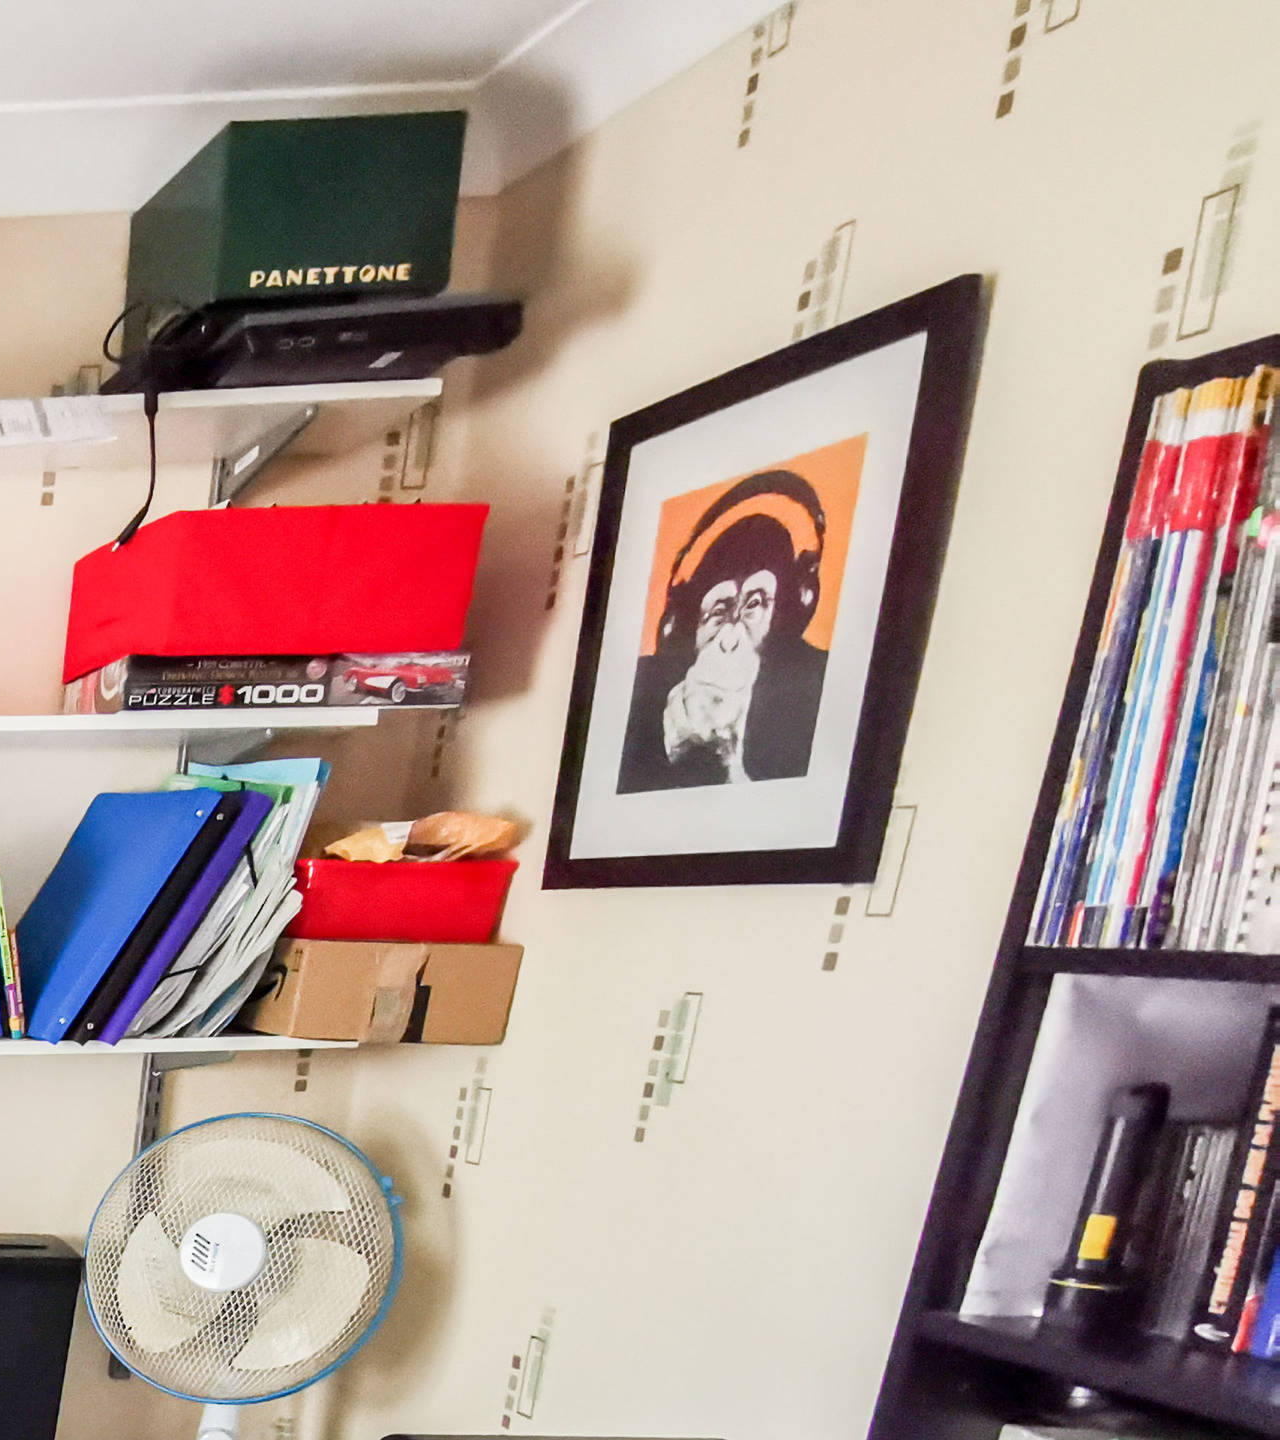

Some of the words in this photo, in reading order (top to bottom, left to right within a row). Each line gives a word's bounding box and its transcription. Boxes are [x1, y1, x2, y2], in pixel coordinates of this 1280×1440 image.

[249, 263, 413, 289] PANETTONE
[128, 694, 216, 706] PUZZLE
[237, 684, 325, 705] 1000
